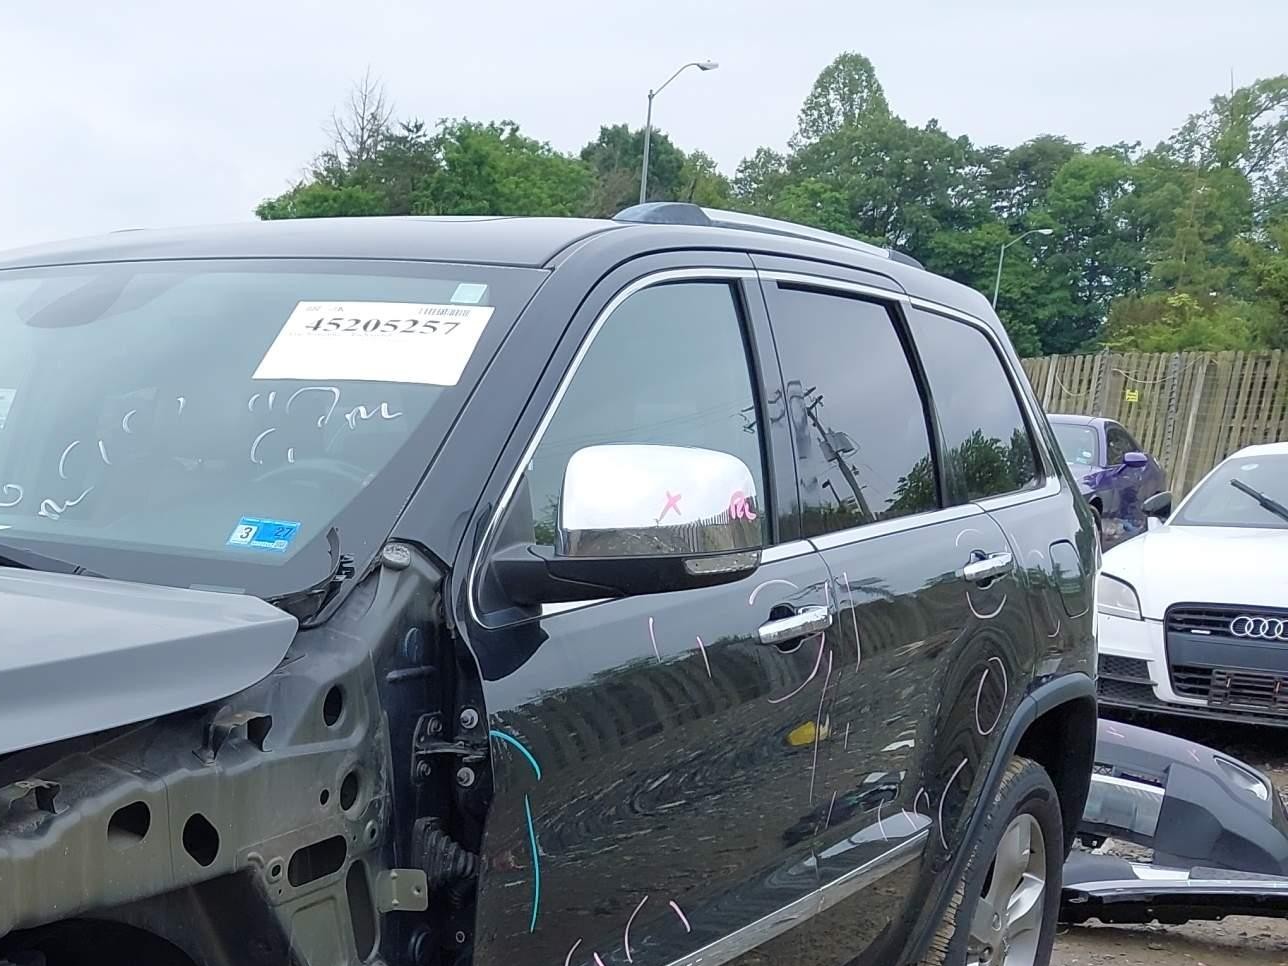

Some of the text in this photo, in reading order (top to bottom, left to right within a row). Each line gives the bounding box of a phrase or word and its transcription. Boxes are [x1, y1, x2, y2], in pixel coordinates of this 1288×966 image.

[305, 316, 462, 336] 45205257
[239, 526, 296, 540] 3 27
